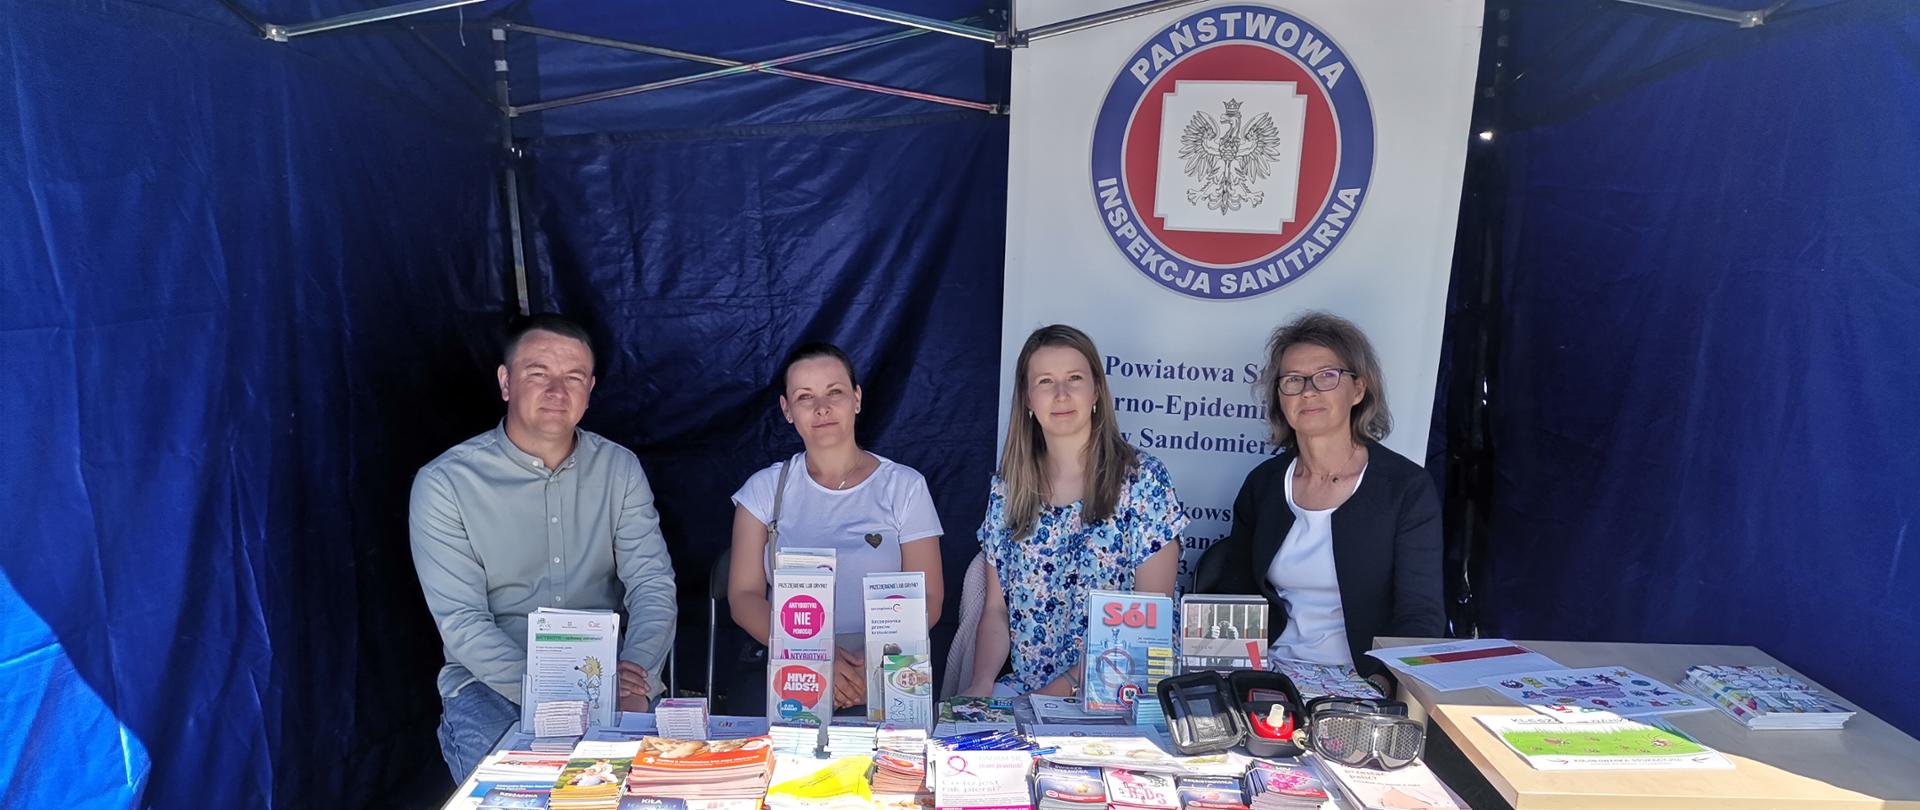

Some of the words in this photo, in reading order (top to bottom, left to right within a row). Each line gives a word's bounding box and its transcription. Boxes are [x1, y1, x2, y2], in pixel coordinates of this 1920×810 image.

[1130, 12, 1346, 89] PAŃSTWOWA
[1097, 177, 1211, 294] INSPEKCJA
[1219, 186, 1361, 294] SANITARNA
[1105, 355, 1235, 383] Powiatowa
[794, 611, 811, 626] NIE
[1102, 602, 1158, 629] Sól
[783, 681, 819, 692] AIDS?!
[787, 672, 817, 683] HIV?!
